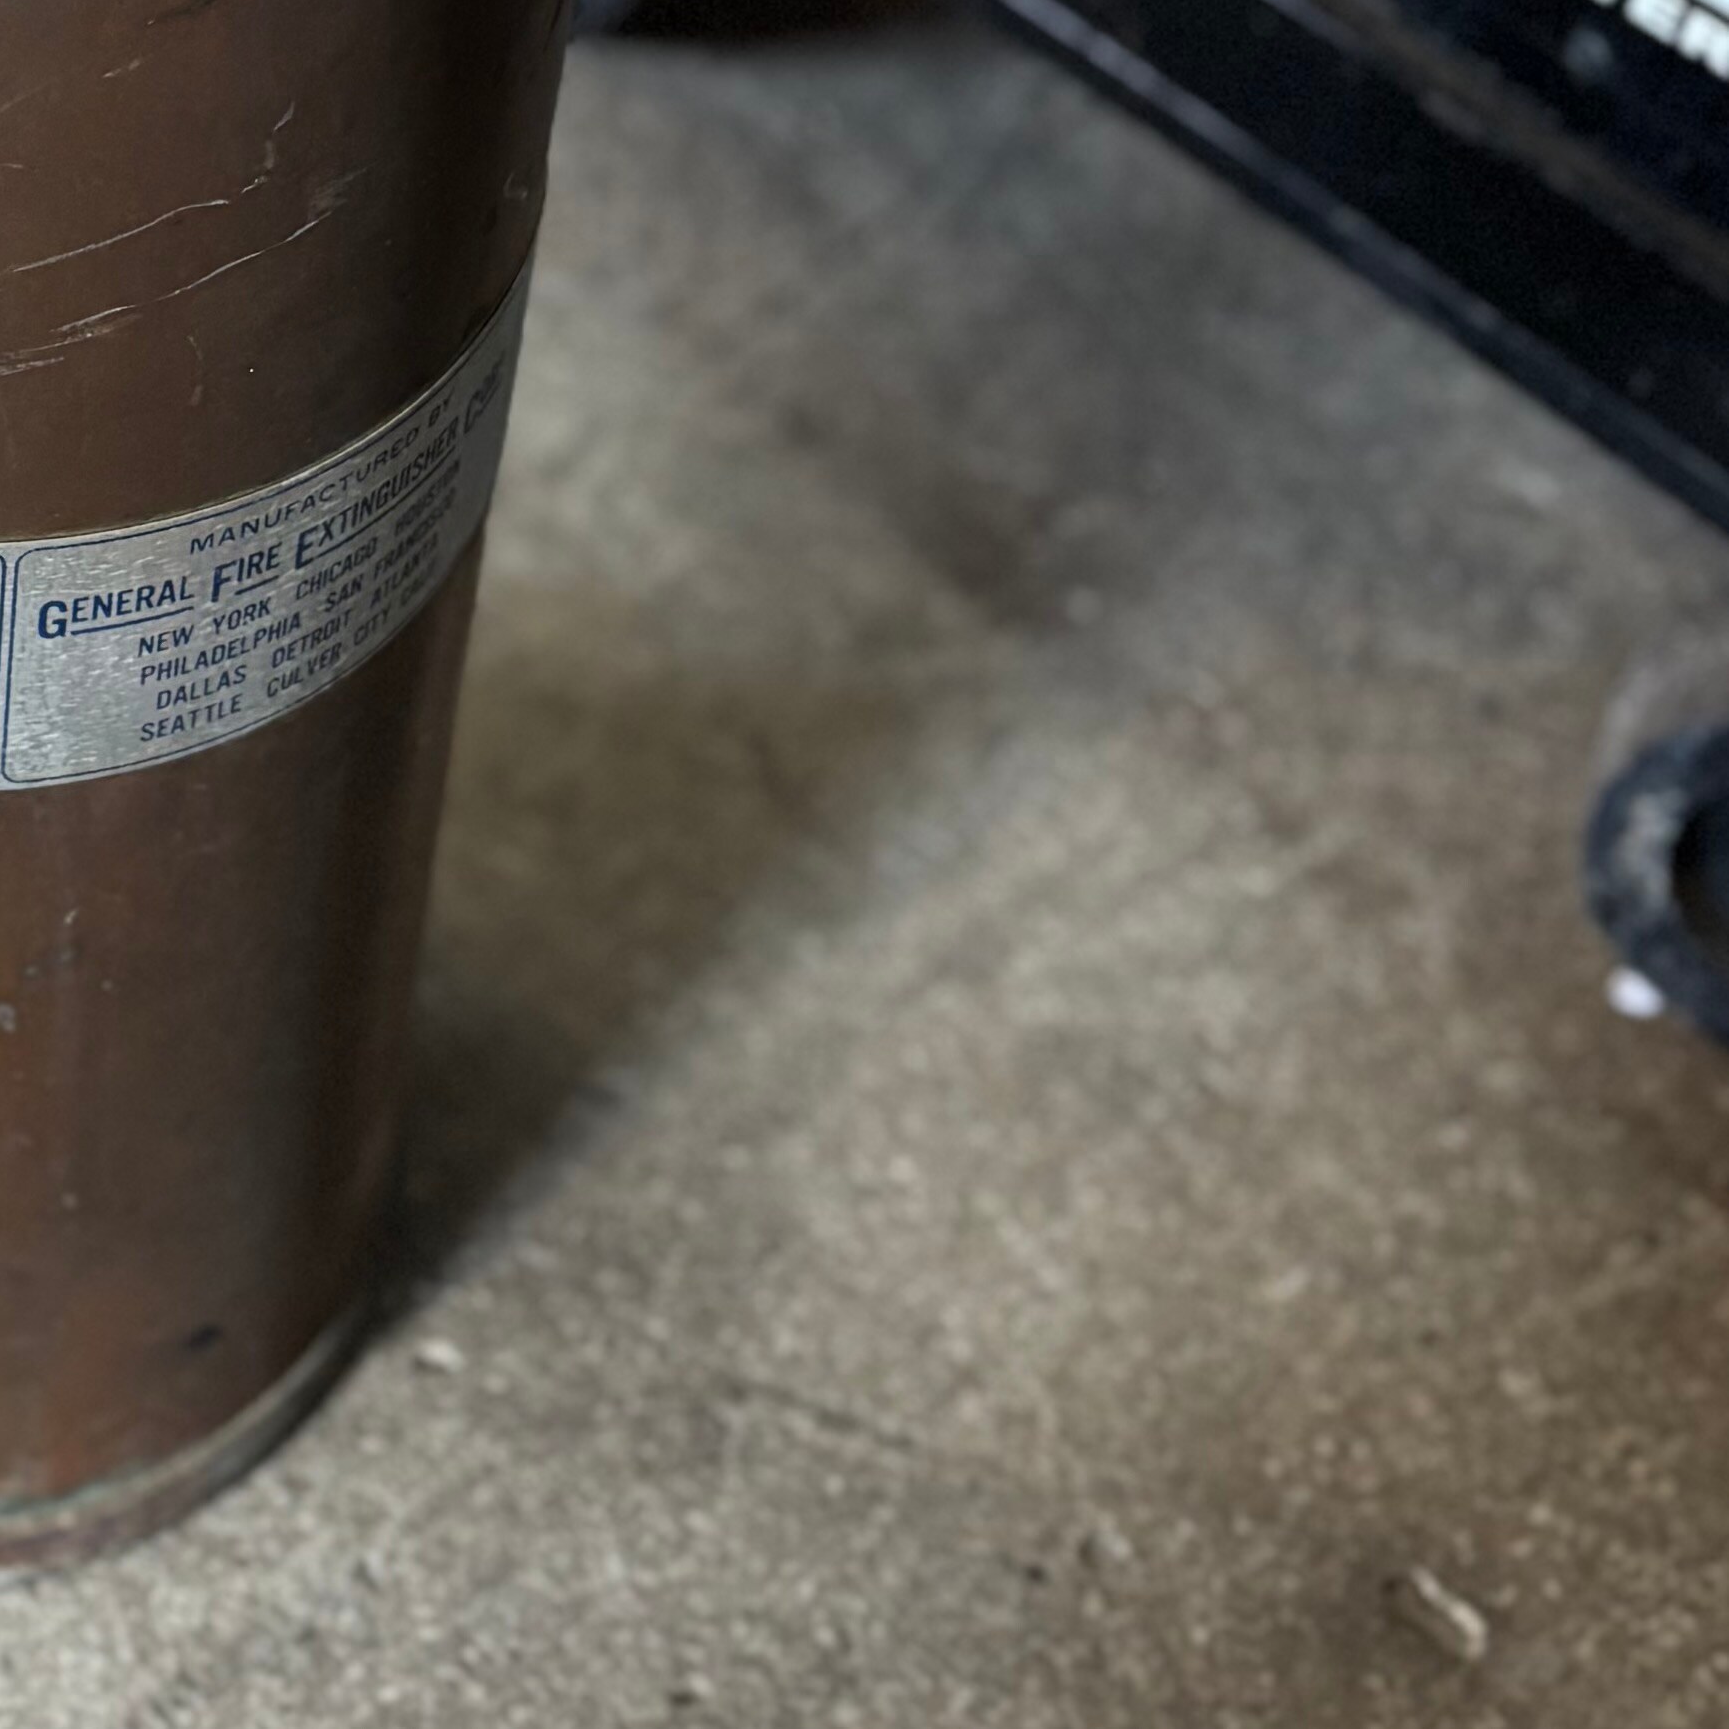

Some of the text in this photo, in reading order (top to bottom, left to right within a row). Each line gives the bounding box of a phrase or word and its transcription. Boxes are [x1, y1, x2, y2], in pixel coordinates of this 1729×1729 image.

[38, 415, 460, 639] GENERAL FIRE EXTINGUISHER
[190, 426, 420, 555] MANUFACTURED
[137, 623, 195, 658] NEW
[213, 597, 272, 635] YORK
[296, 536, 378, 601] CHICAGO
[140, 612, 301, 686] PHILADELPHIA
[324, 574, 363, 613] SAN
[139, 693, 244, 743] SEATTLE
[267, 641, 342, 698] CULVER
[157, 665, 247, 711] DALLAS
[272, 608, 352, 669] DETROIT
